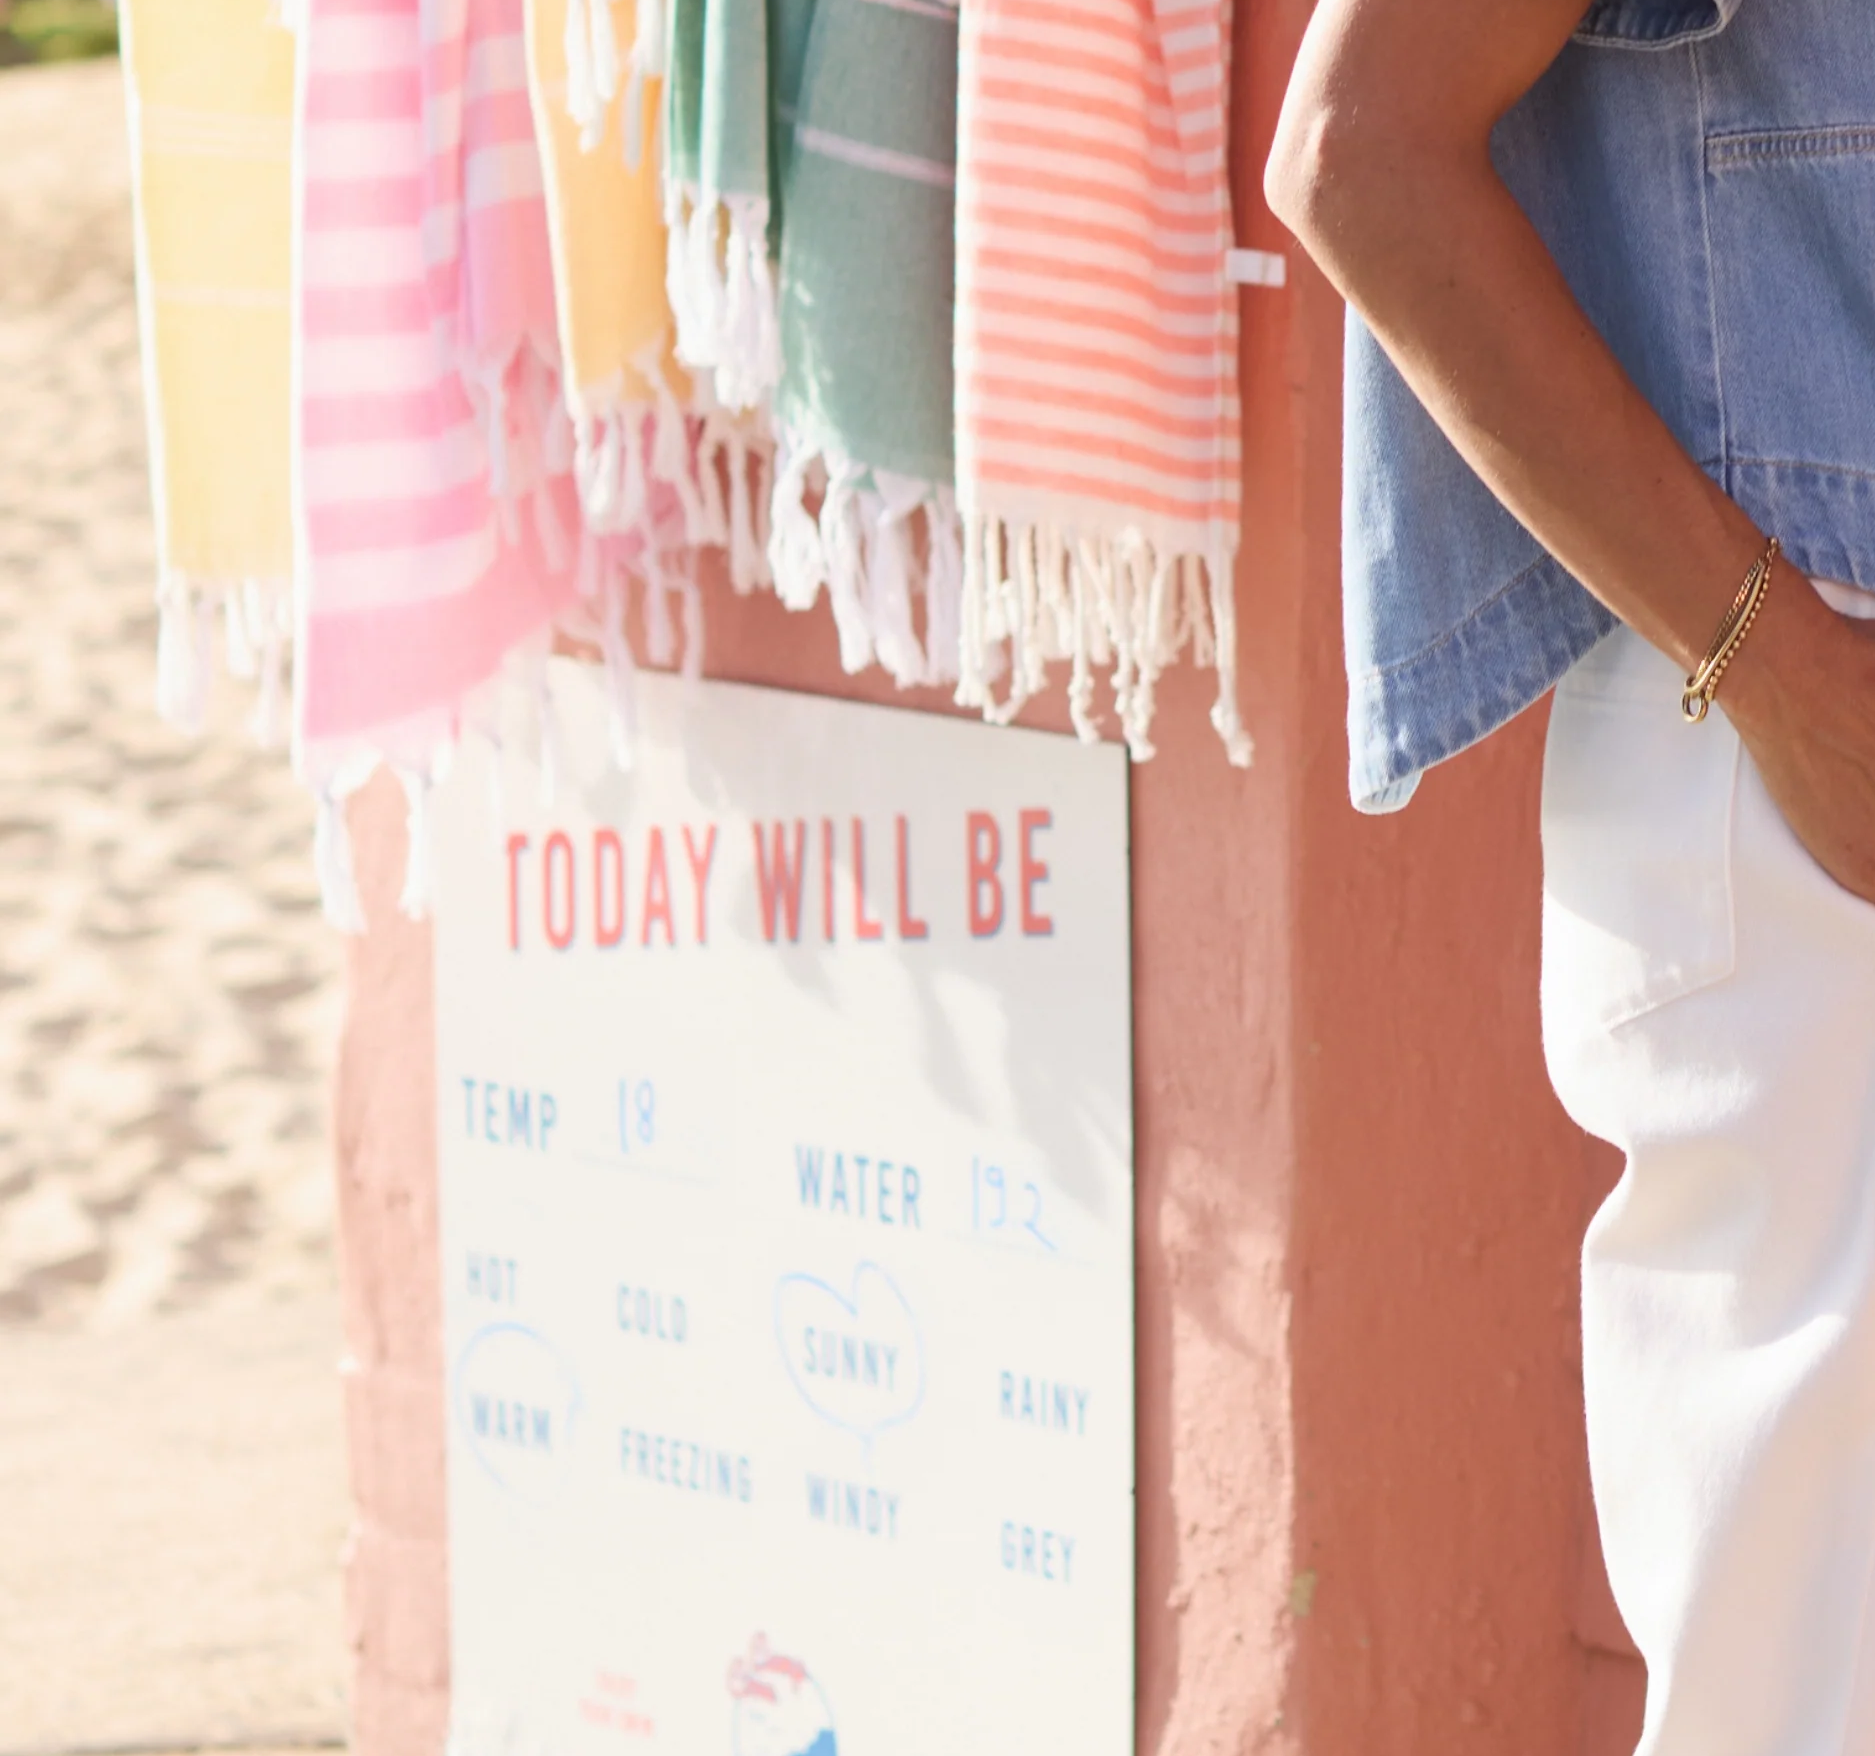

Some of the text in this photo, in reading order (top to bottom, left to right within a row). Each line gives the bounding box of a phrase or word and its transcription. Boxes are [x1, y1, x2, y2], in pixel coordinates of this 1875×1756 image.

[506, 808, 1053, 949] TODAY WILL BE
[461, 1078, 655, 1154] TEMP 18
[795, 1143, 922, 1230] WATER
[466, 1251, 517, 1306] HOT
[617, 1282, 687, 1344] COLD
[804, 1326, 898, 1392] SUNNY
[470, 1392, 552, 1454] WARM
[1000, 1369, 1092, 1436] RAINY
[620, 1426, 753, 1504] FREEZING
[806, 1471, 900, 1540] WINDY
[1000, 1521, 1077, 1587] GREY
